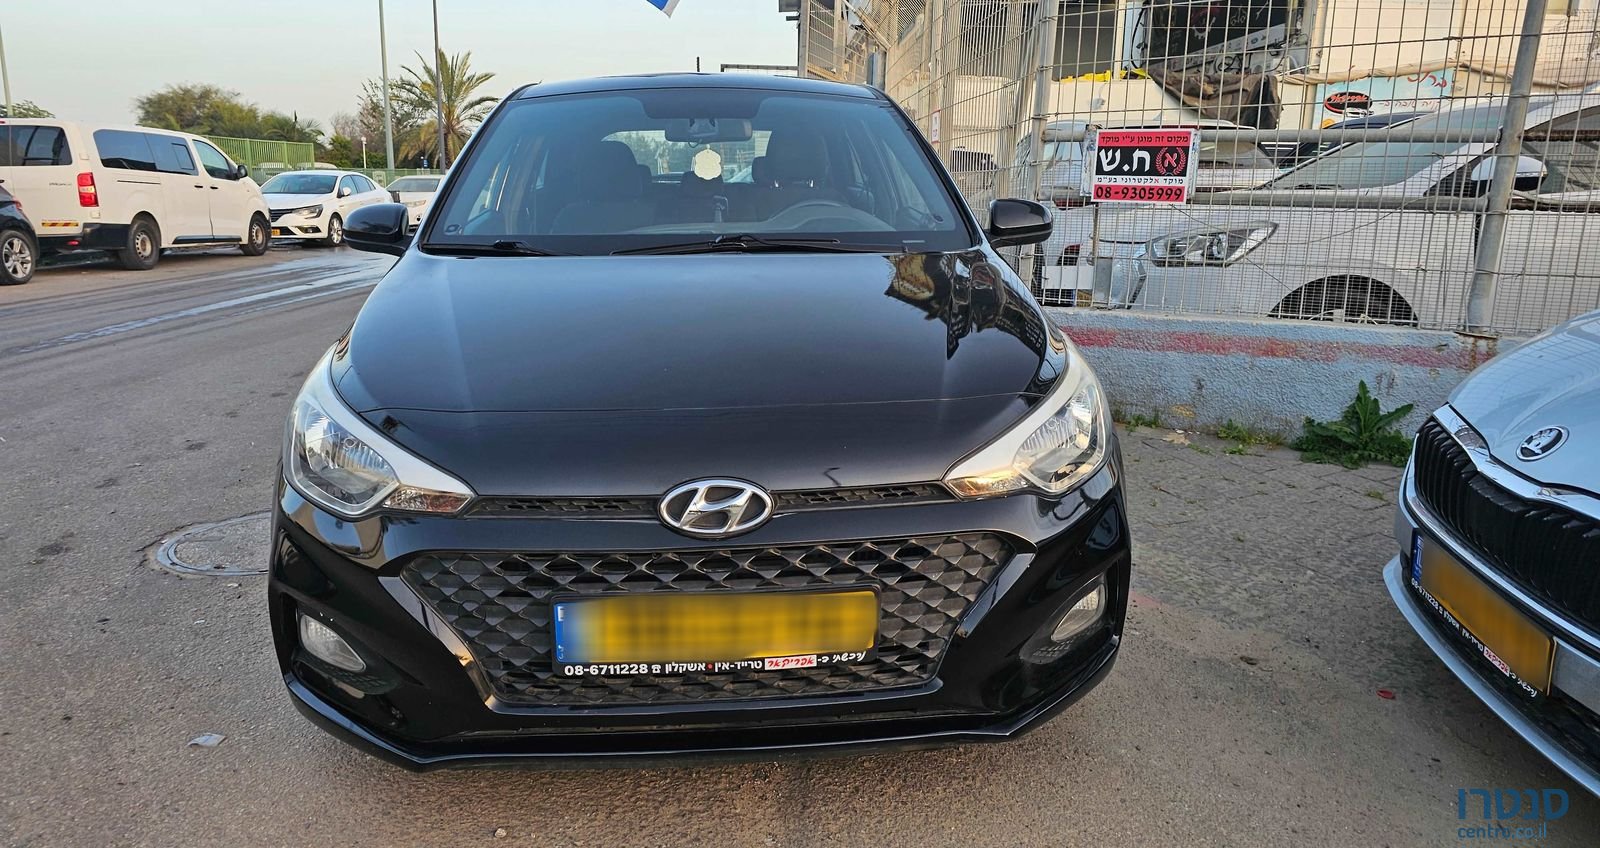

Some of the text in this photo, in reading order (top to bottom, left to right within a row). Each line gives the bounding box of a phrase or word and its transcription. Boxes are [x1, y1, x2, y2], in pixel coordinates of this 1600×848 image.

[1100, 136, 1120, 145] מוקד
[1166, 135, 1189, 144] מקום
[1121, 176, 1160, 185] אלקטרוני
[1163, 177, 1184, 185] מוקד
[1095, 186, 1183, 201] 08-9305999
[564, 663, 648, 676] 08-6711228
[665, 661, 706, 674] אשקלון
[714, 659, 763, 673] טרייד-אין
[766, 658, 816, 670] אפריקאר
